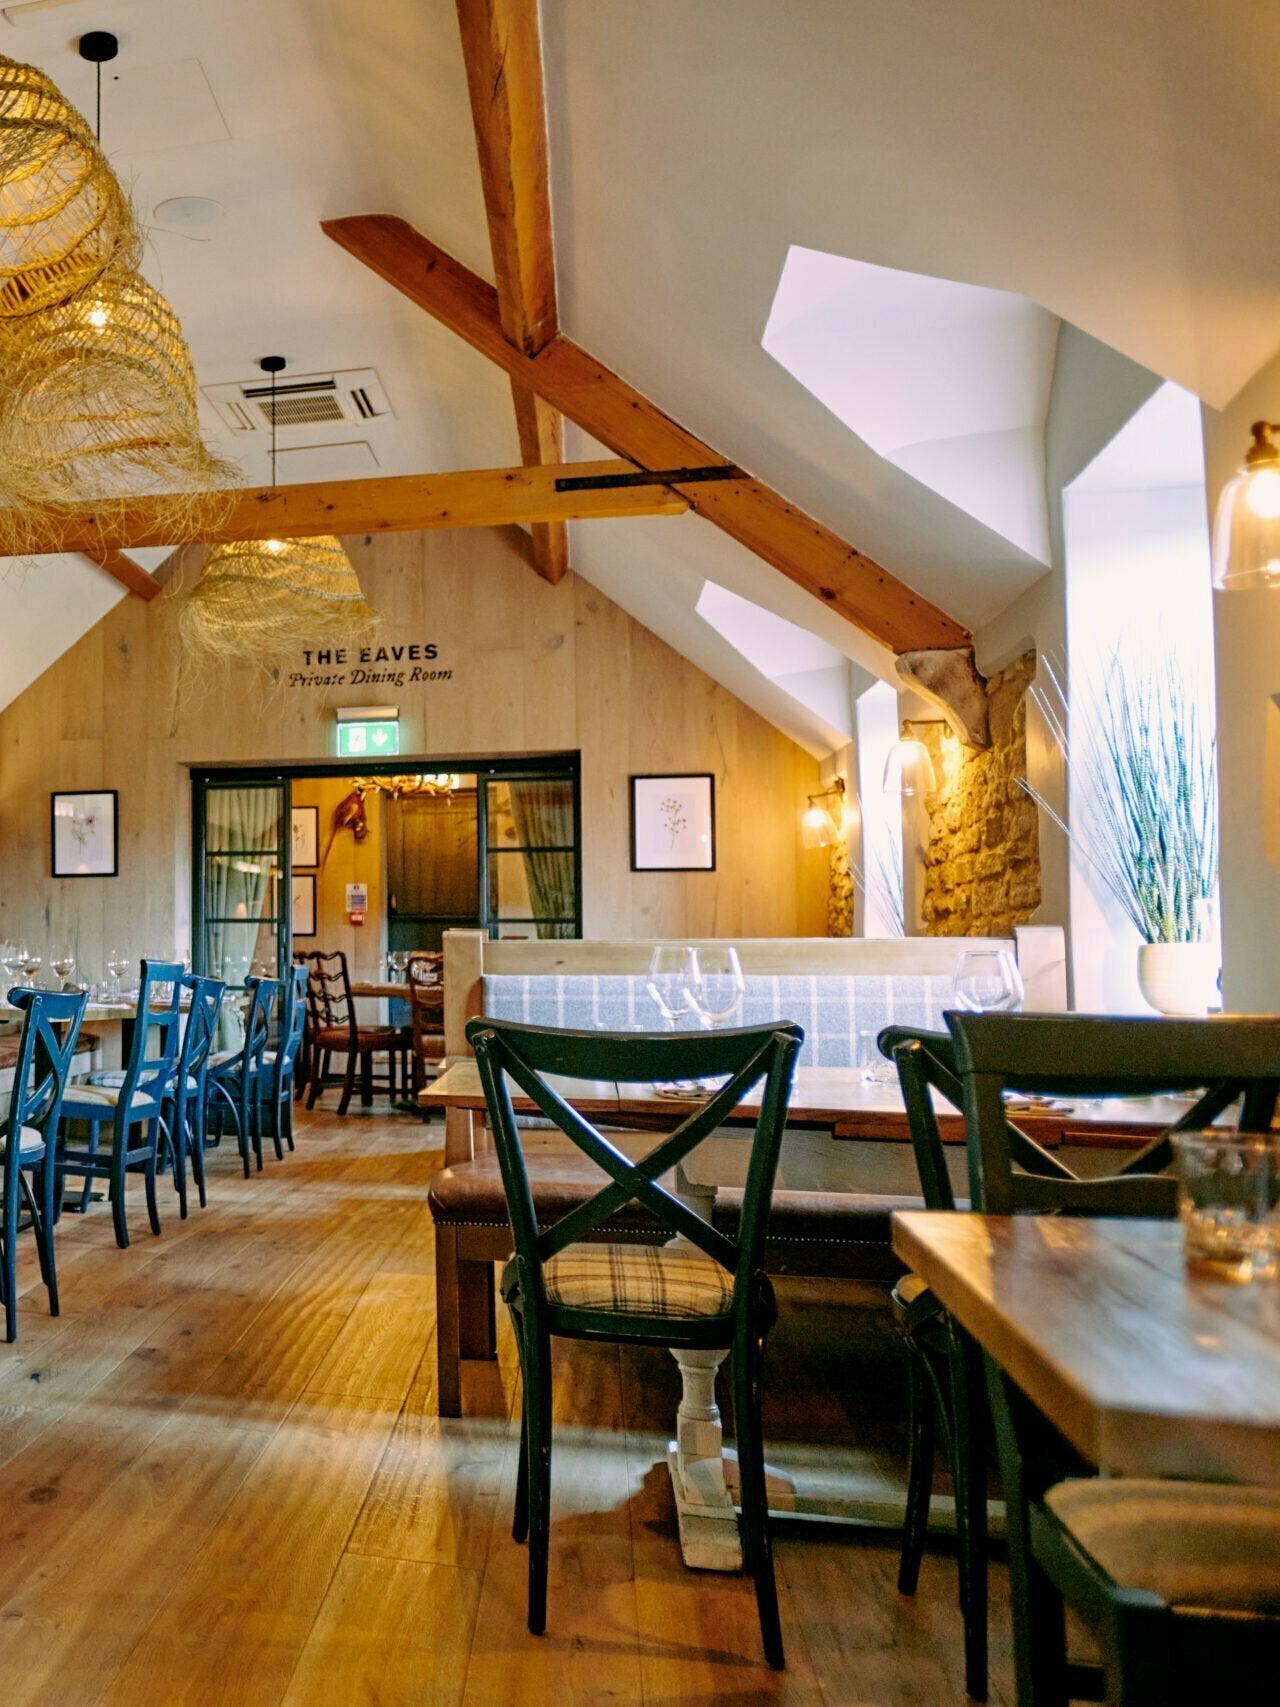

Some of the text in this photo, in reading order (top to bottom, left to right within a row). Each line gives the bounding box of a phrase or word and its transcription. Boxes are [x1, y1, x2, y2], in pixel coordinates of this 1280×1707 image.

[303, 644, 439, 666] THE EAVES
[289, 666, 453, 688] Private Dining Room
